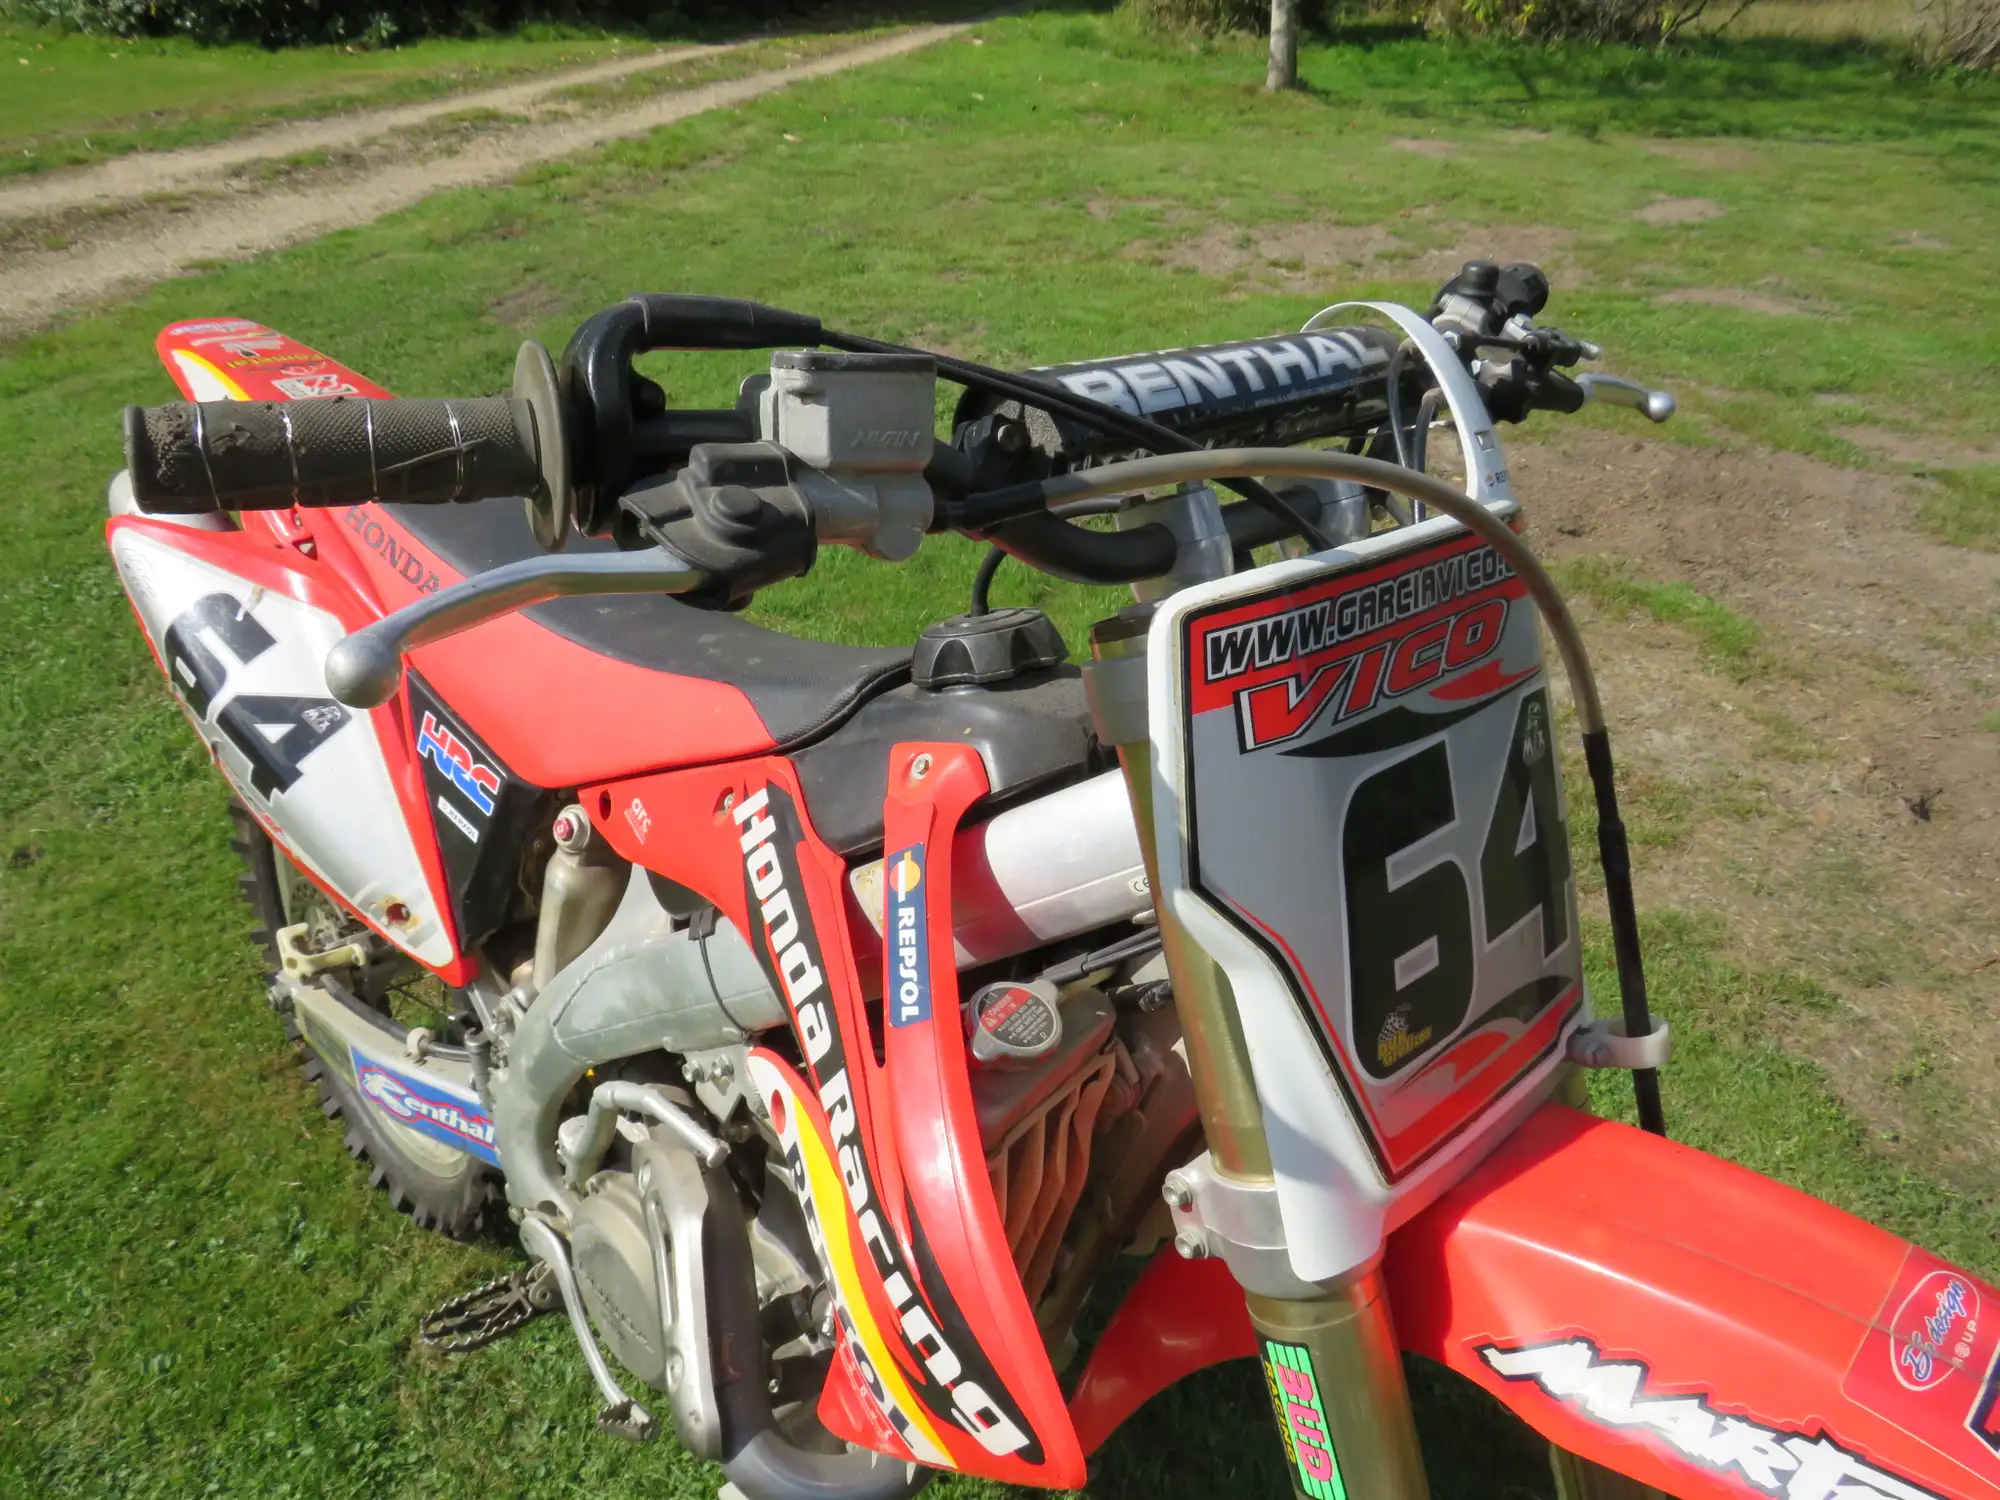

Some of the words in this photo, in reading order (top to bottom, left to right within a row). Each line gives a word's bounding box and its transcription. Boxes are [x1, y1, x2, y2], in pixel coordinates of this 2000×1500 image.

[1059, 331, 1392, 417] RENTHAL
[343, 505, 440, 593] HONDA
[1232, 598, 1510, 754] VICO
[417, 711, 500, 817] HRC
[1342, 685, 1571, 1079] 64
[897, 906, 920, 1022] REPSOL
[362, 1073, 495, 1143] Renthal
[732, 787, 834, 1066] Honda
[818, 1067, 1030, 1457] Racing
[1264, 1360, 1296, 1464] RACING
[1276, 1361, 1333, 1482] BUD
